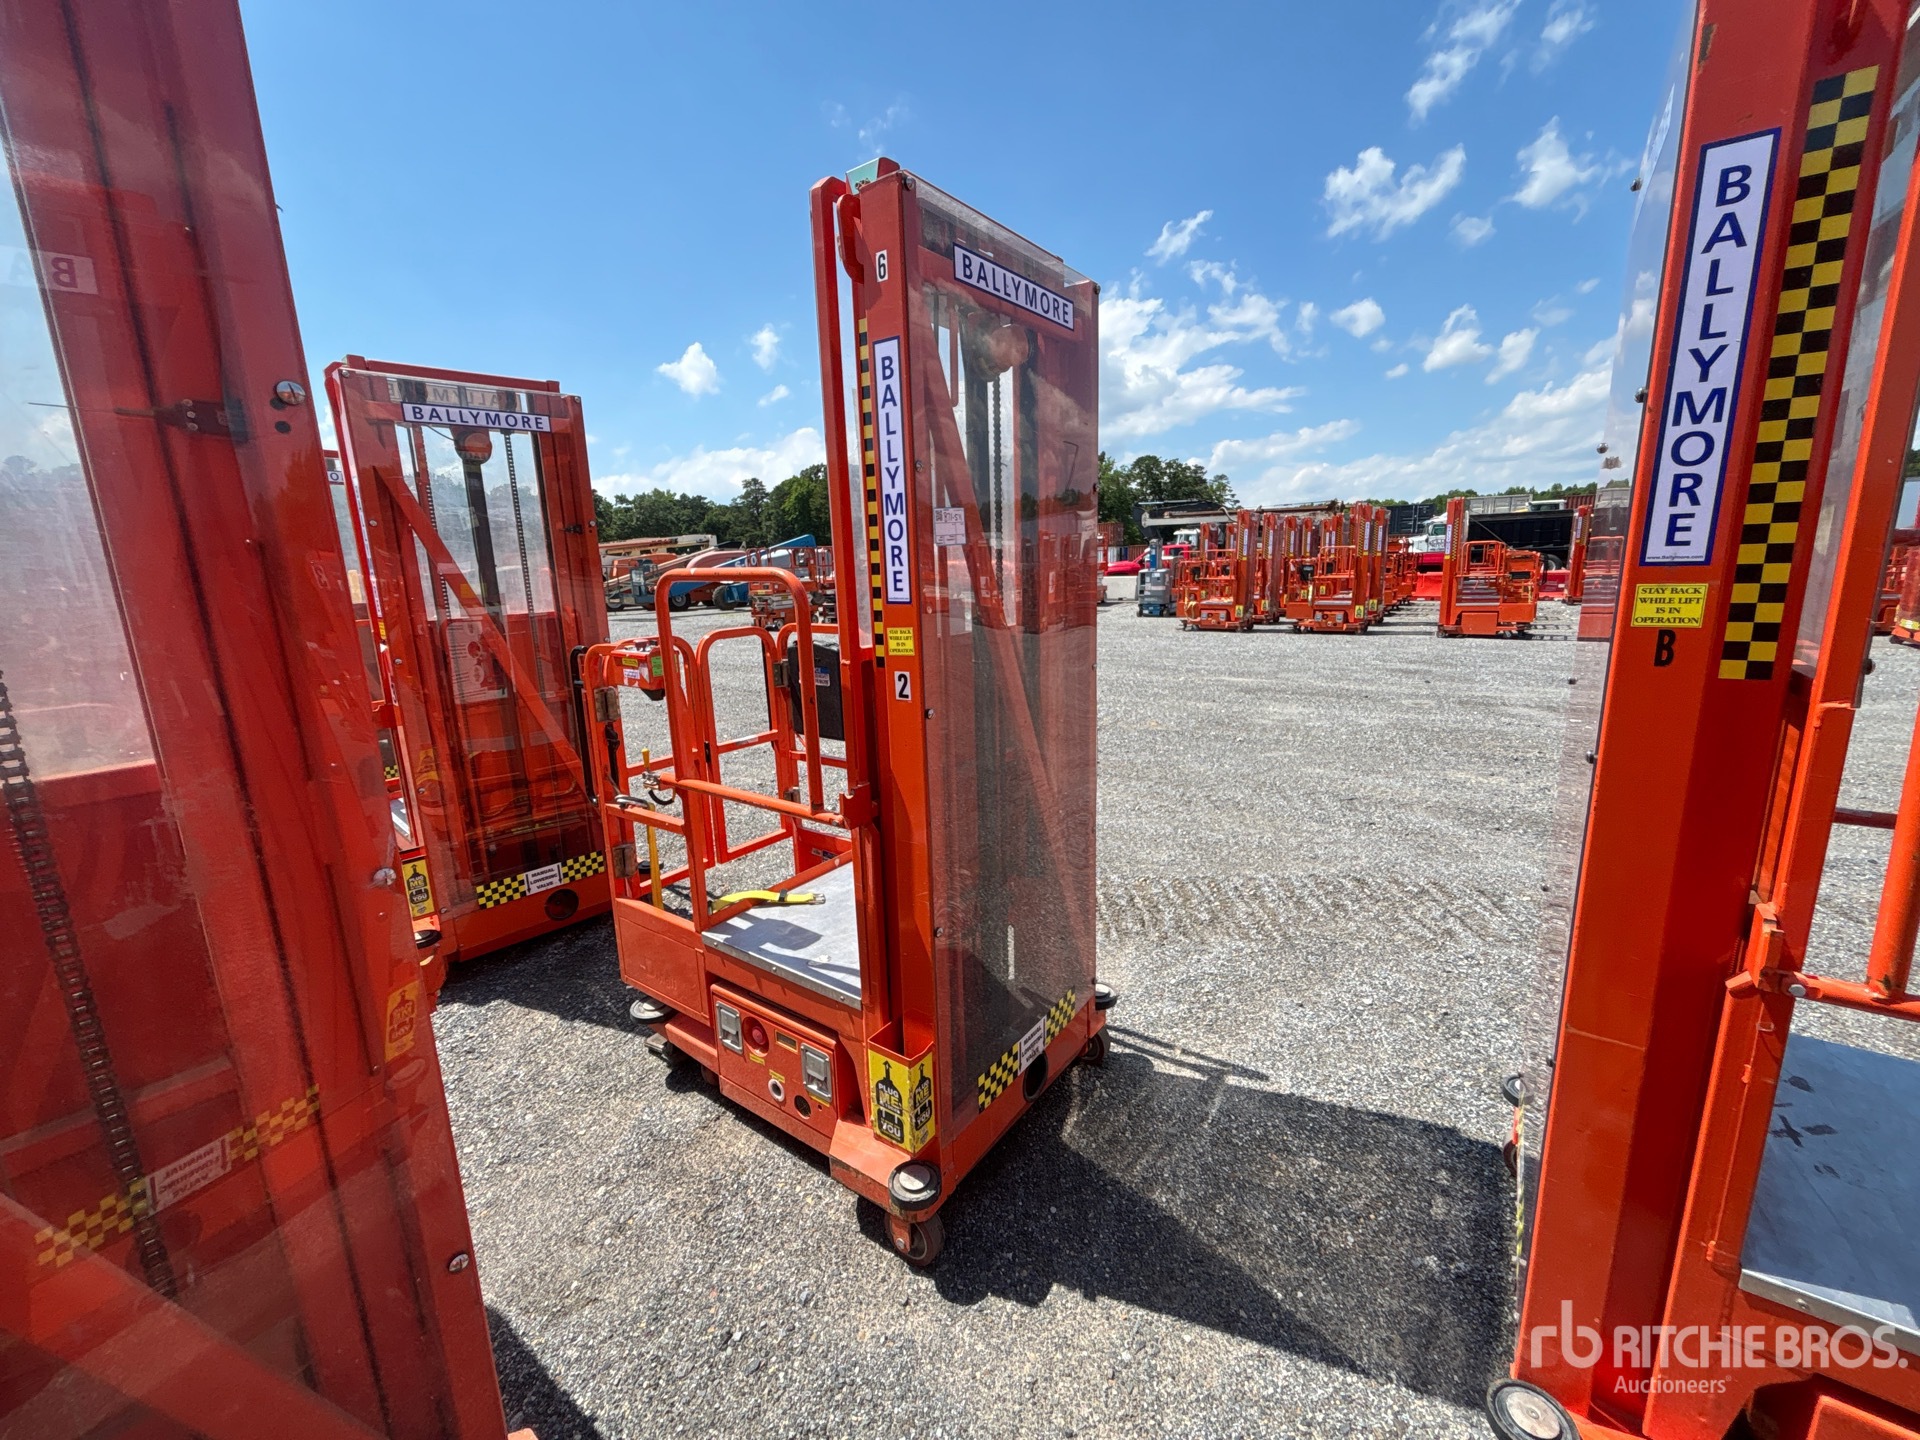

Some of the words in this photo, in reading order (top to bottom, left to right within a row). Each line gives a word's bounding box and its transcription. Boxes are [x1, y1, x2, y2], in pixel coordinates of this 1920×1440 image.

[877, 253, 887, 279] 6
[962, 253, 1070, 325] BALLYMORE
[1665, 163, 1752, 547] BALLYMORE
[411, 406, 544, 430] BALLYMORE
[881, 355, 905, 592] BALLYMORE
[1641, 587, 1668, 595] STAY
[1670, 587, 1702, 595] BACK
[1635, 617, 1700, 625] OPERATION
[1654, 629, 1676, 667] B
[898, 673, 909, 699] 2
[531, 867, 555, 877] MANUAL
[412, 892, 428, 902] YOU
[878, 1082, 899, 1098] PLUG
[879, 1090, 900, 1107] ME
[916, 1108, 931, 1125] YOU
[881, 1119, 901, 1136] YOU
